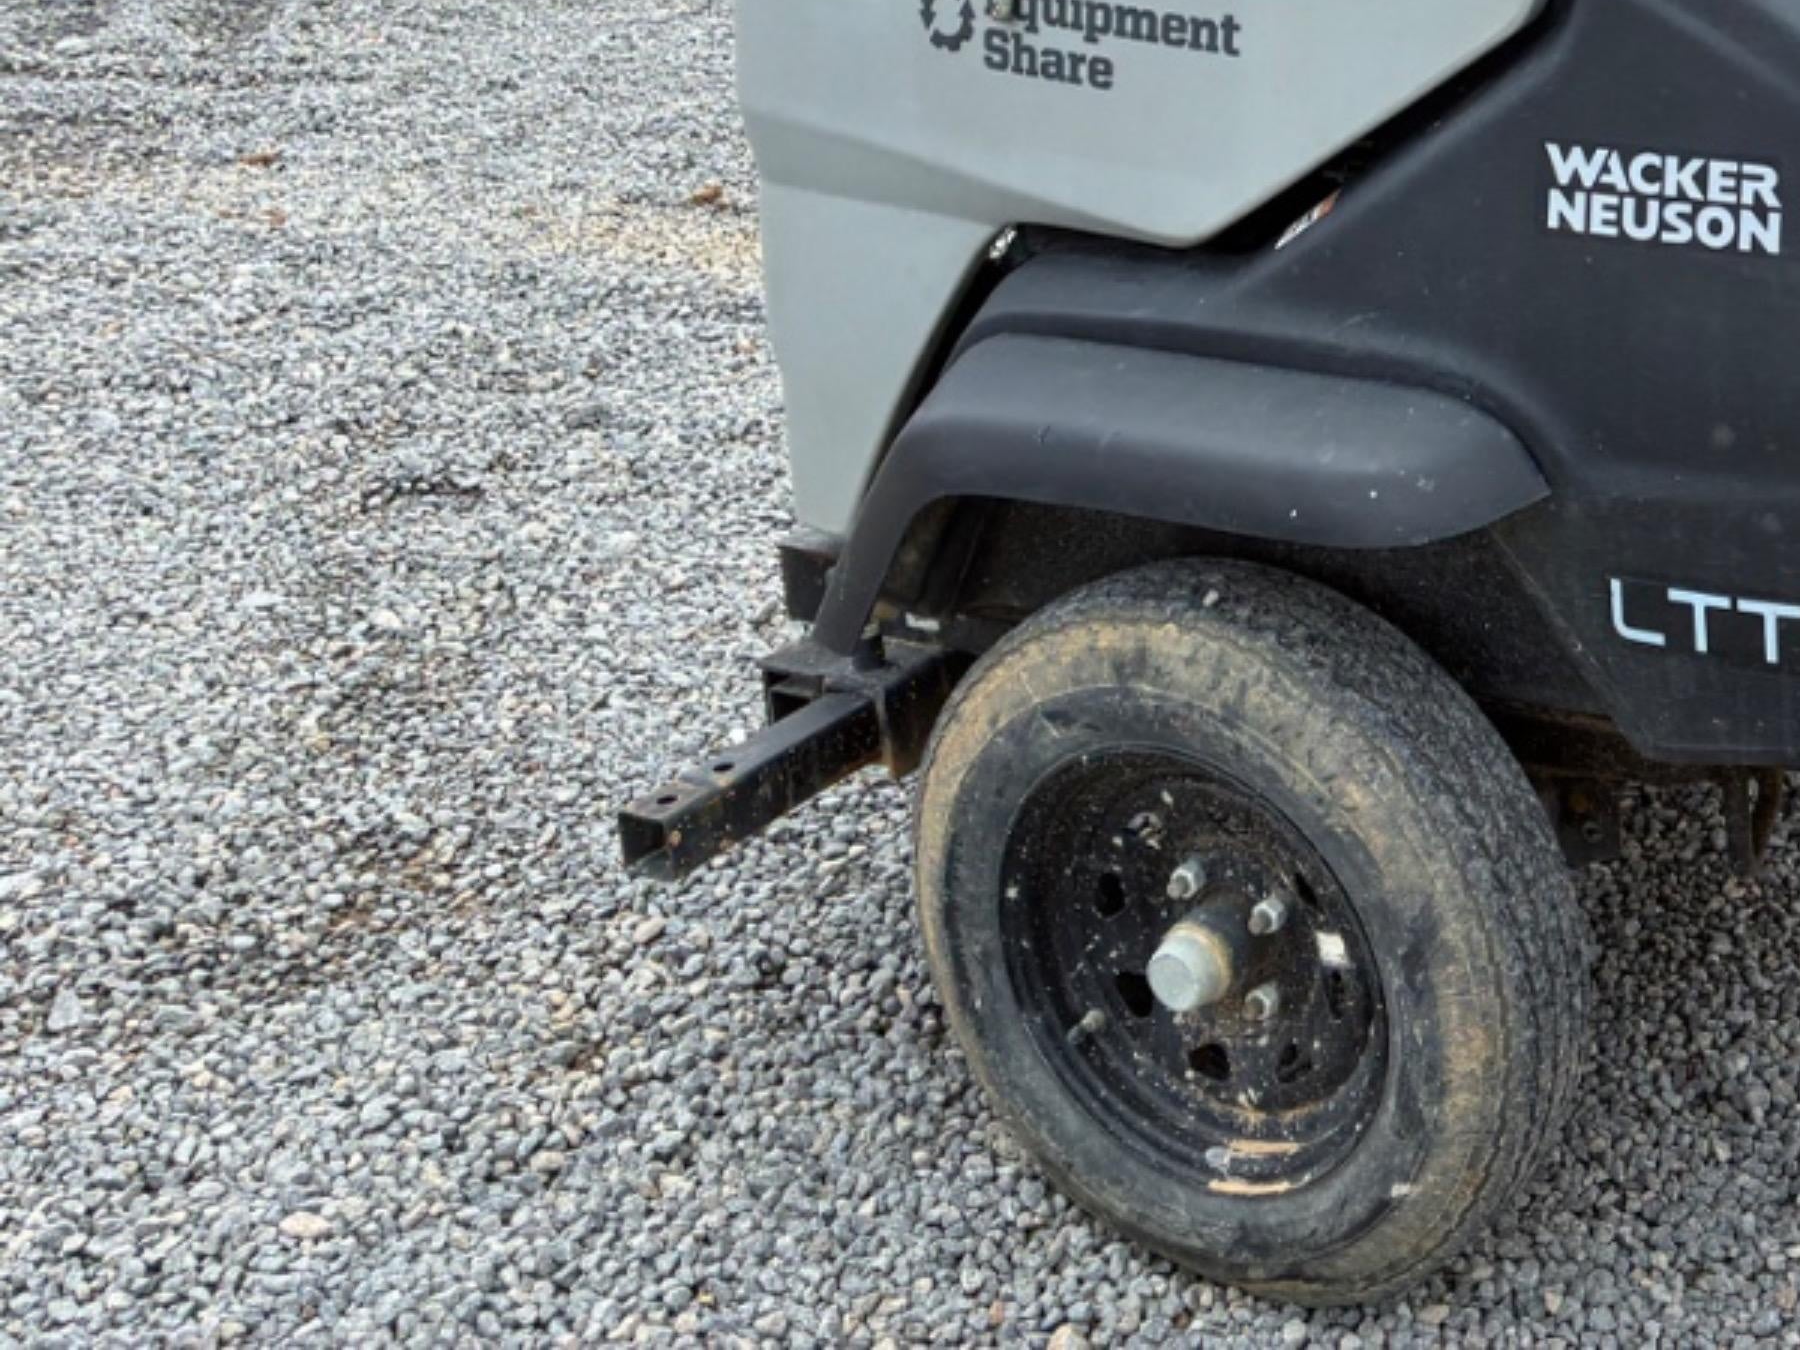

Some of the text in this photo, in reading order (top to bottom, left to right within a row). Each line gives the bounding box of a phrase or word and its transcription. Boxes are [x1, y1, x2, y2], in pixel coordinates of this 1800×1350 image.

[983, 26, 1115, 90] Share
[1544, 141, 1782, 209] WACKER
[1547, 187, 1783, 257] NEUSON
